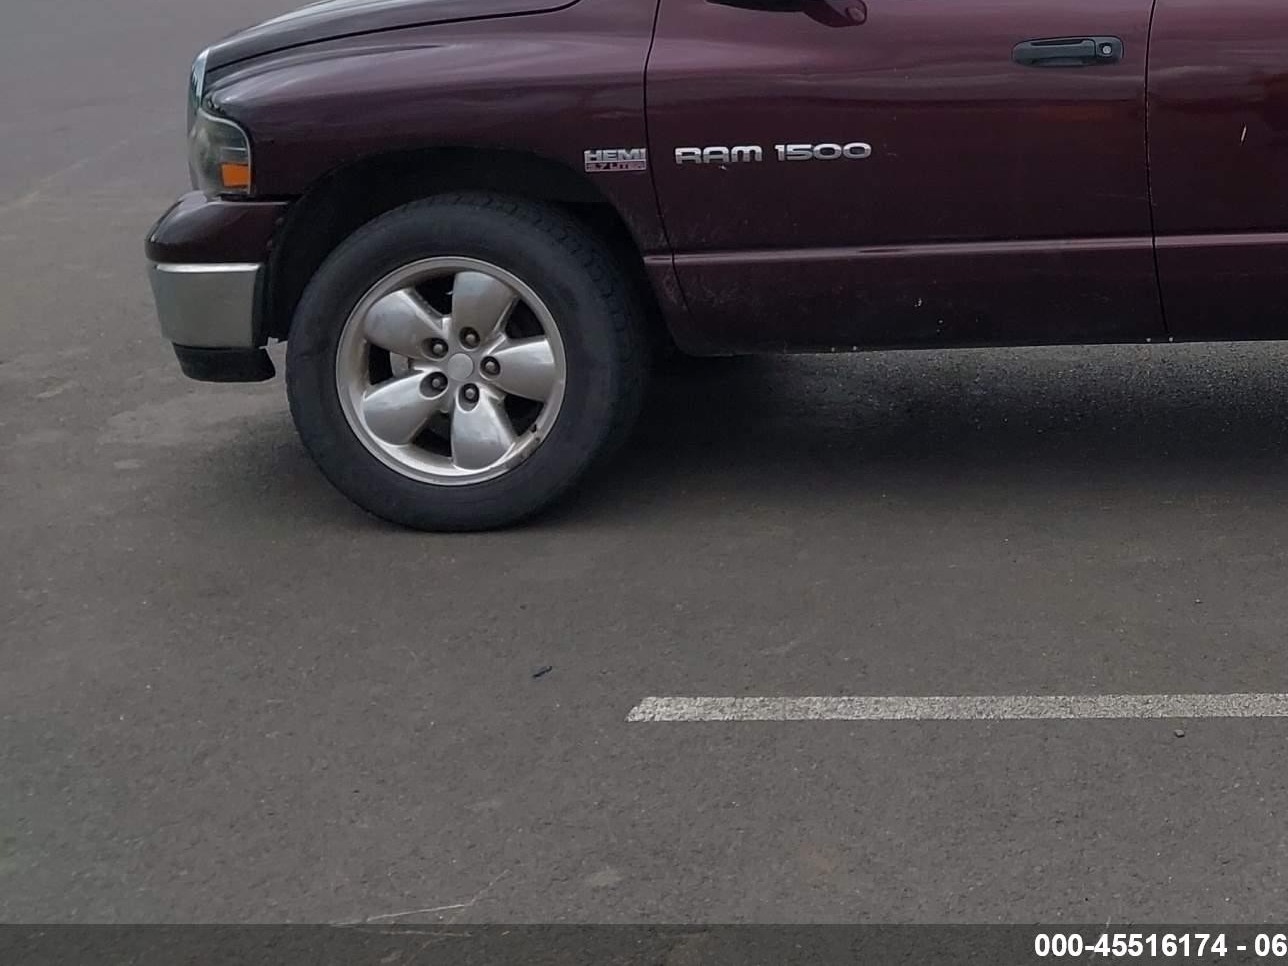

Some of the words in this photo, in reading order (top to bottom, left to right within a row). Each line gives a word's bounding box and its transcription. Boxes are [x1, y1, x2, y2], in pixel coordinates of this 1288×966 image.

[584, 148, 646, 163] HEMI
[675, 145, 762, 164] RAM
[774, 142, 872, 161] 1500
